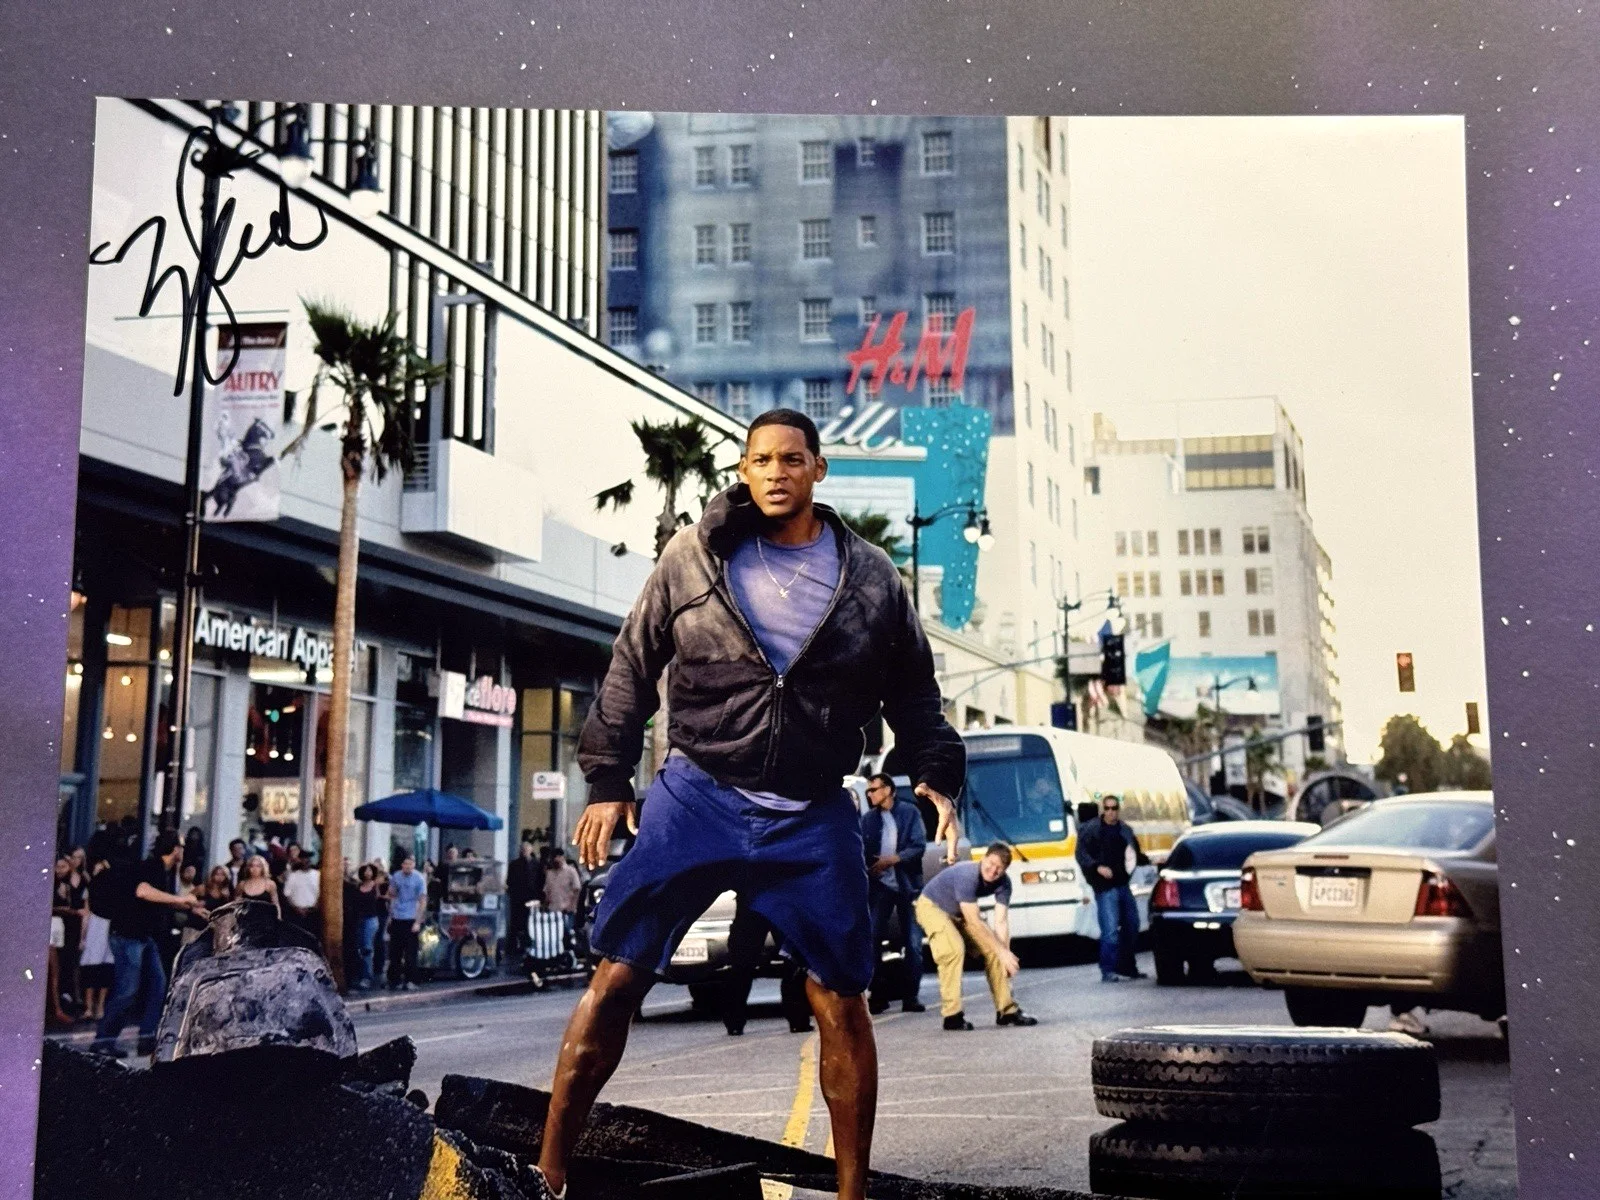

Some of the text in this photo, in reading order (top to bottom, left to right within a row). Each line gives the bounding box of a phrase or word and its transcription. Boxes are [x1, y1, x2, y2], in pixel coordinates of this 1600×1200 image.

[841, 305, 976, 394] H&M
[224, 370, 283, 392] AUTRY
[194, 607, 289, 660] American
